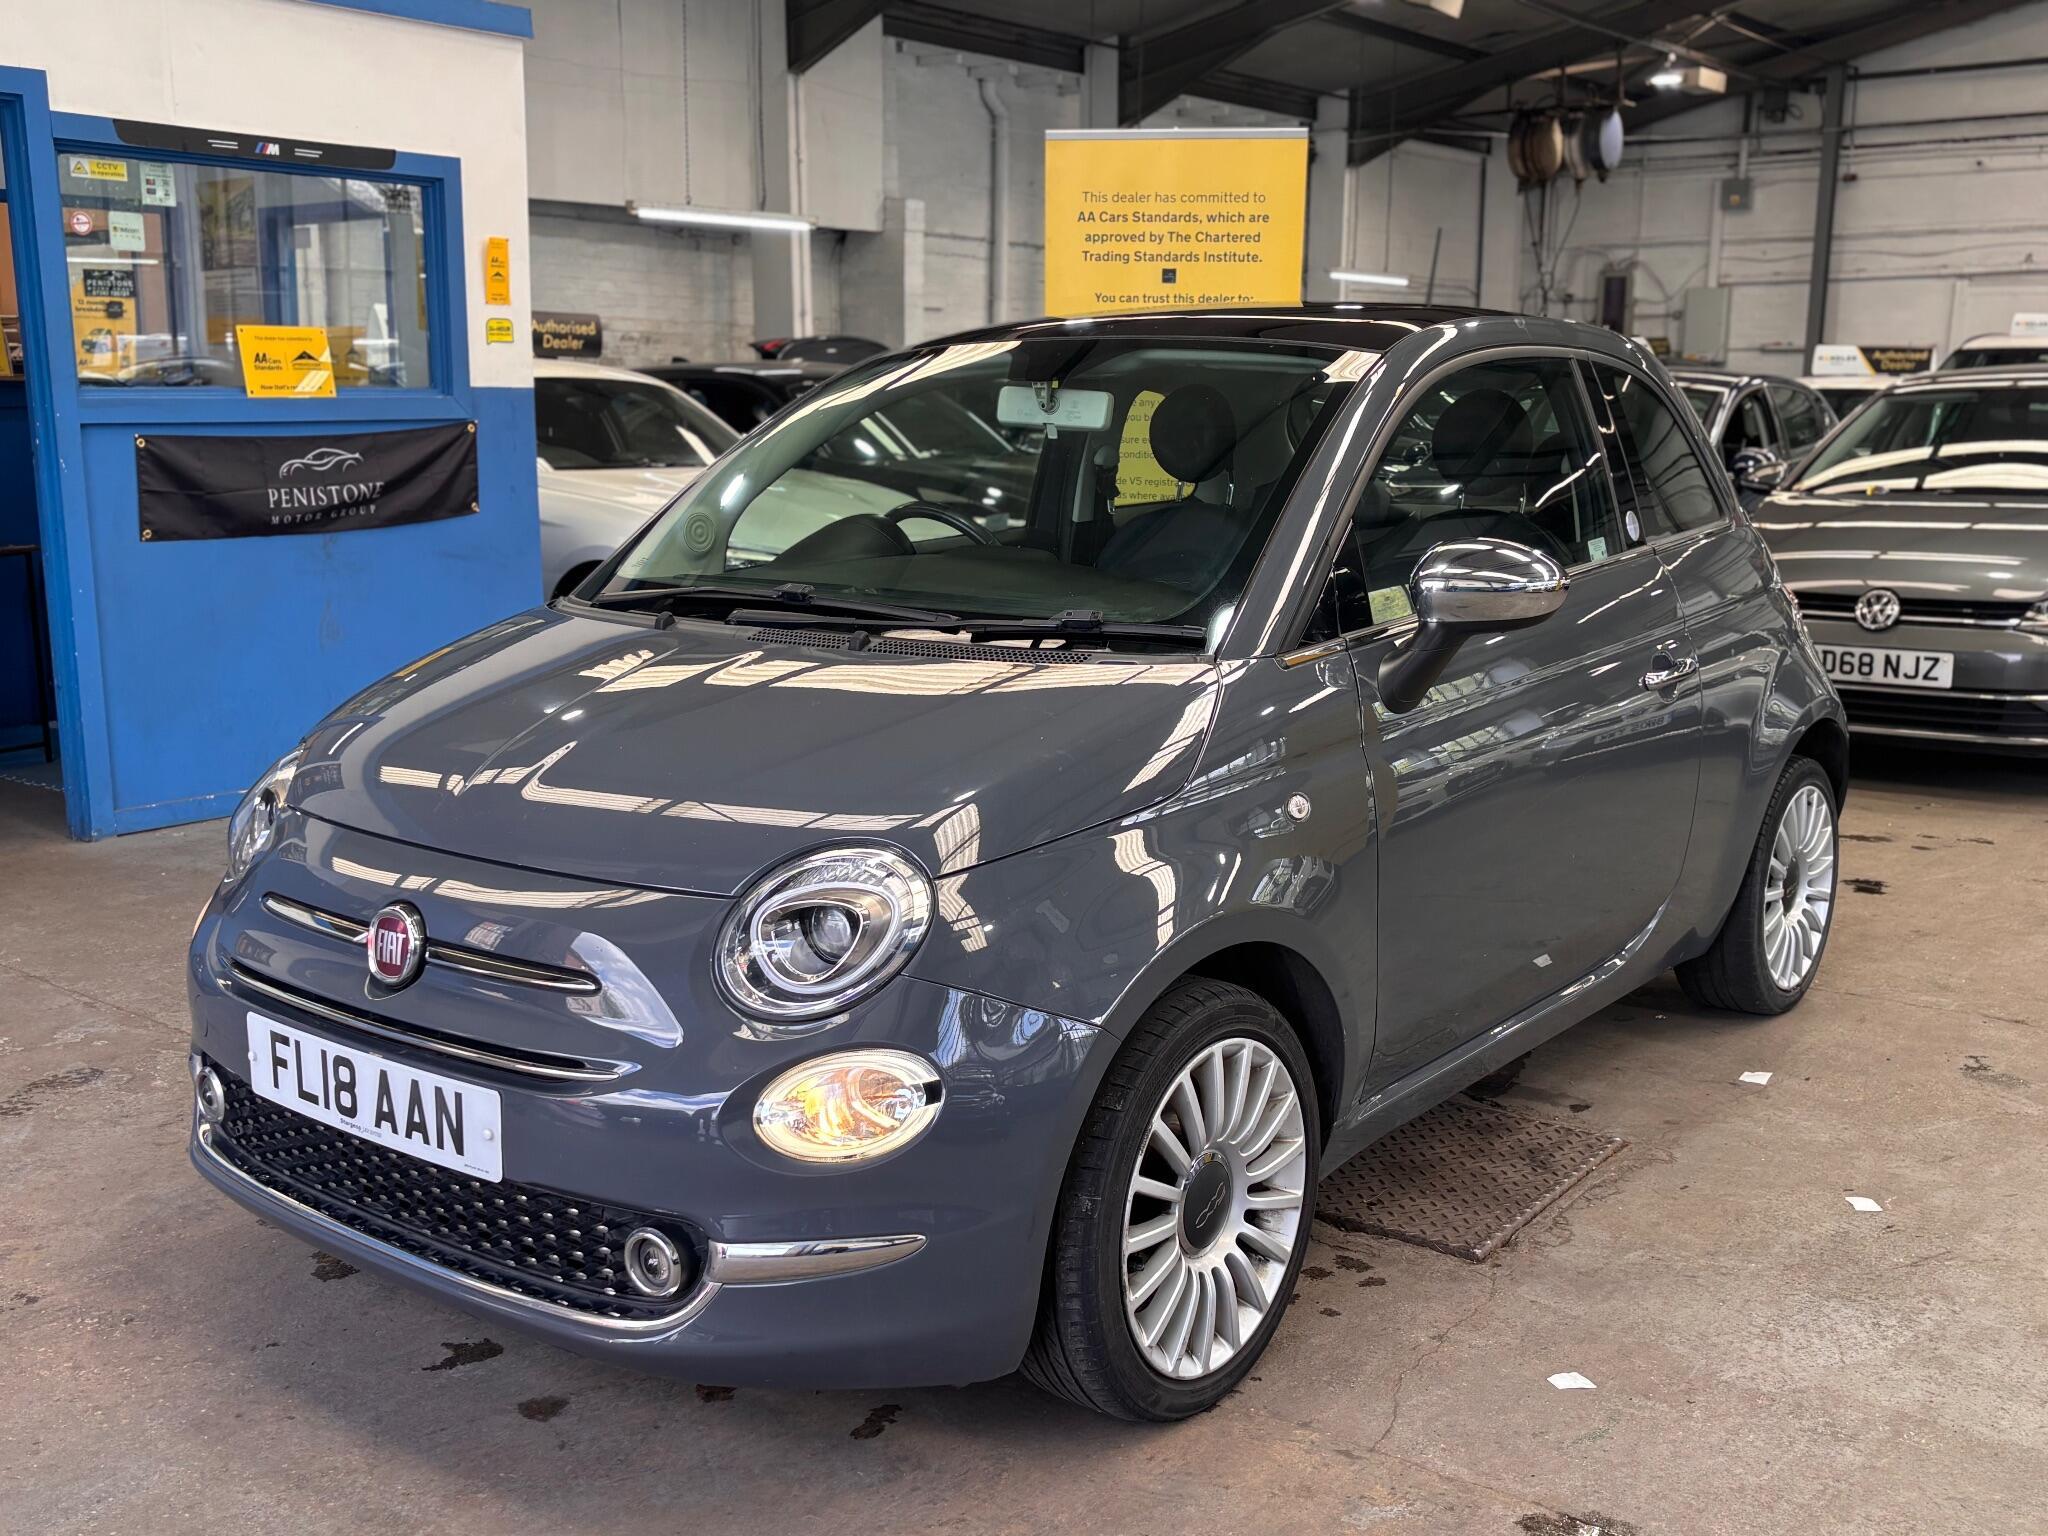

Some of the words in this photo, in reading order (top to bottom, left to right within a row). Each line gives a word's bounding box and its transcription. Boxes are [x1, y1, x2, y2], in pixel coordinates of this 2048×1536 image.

[1082, 191, 1108, 203] This
[1112, 192, 1150, 203] dealer
[1155, 192, 1177, 203] has
[1180, 192, 1249, 203] committed
[1252, 193, 1266, 203] to
[1077, 211, 1096, 223] AA
[1099, 211, 1129, 223] Cars
[1132, 211, 1203, 224] Standards,
[1206, 212, 1245, 223] which
[1248, 214, 1270, 223] are
[1084, 232, 1146, 246] approved
[1149, 232, 1165, 246] by
[1167, 231, 1192, 243] The
[1195, 231, 1261, 243] Chartered
[1082, 251, 1130, 265] Trading
[1133, 251, 1200, 263] Standards
[1203, 251, 1263, 263] Institute.
[1095, 292, 1116, 304] You
[1119, 295, 1140, 304] can
[1142, 293, 1170, 304] trust
[1173, 293, 1195, 304] this
[1198, 293, 1234, 304] dealer
[531, 319, 597, 336] Authorised
[542, 334, 585, 350] Dealer
[254, 352, 267, 364] AA
[1138, 399, 1155, 408] any
[1129, 476, 1142, 486] V5
[267, 482, 385, 508] PENISTONE
[1130, 491, 1158, 501] where
[271, 512, 323, 525] MOTOR
[330, 504, 376, 519] GROUP
[1822, 649, 1874, 677] D68
[1883, 654, 1941, 682] NJZ
[378, 928, 407, 966] FIAT
[269, 1029, 358, 1120] FL18
[374, 1068, 465, 1157] AAN
